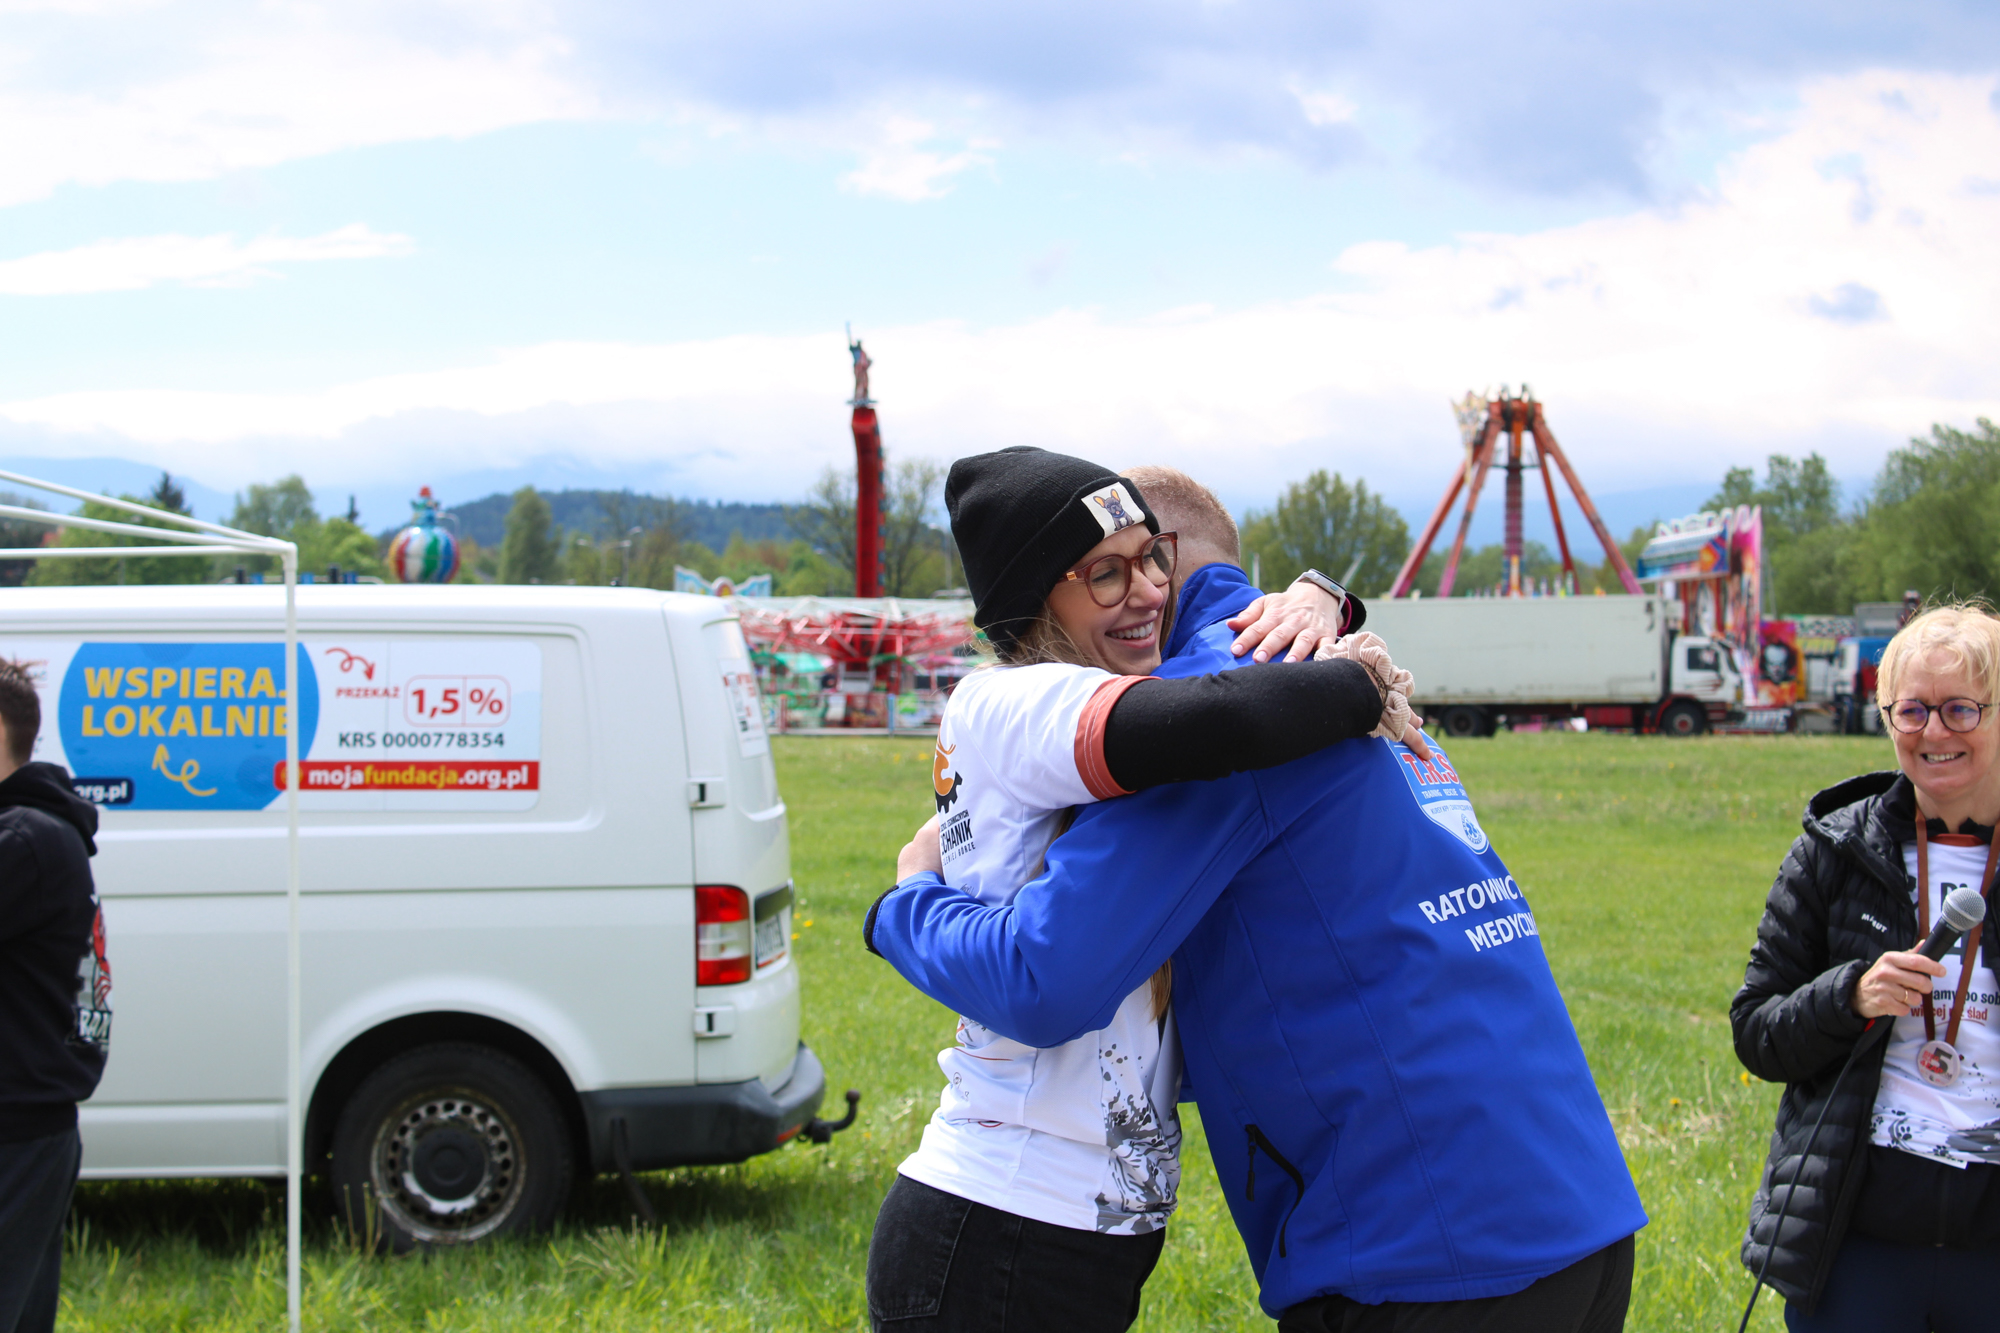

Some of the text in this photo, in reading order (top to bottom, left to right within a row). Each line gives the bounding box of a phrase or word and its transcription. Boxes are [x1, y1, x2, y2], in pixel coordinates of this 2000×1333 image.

[84, 667, 287, 698] WSPIERA
[82, 705, 287, 737] LOKALNIE
[338, 732, 505, 749] KRS 0000778354
[308, 764, 529, 790] mojafundacja.org.pl
[73, 781, 128, 802] org.pl
[941, 819, 973, 855] CHANIK
[1464, 911, 1540, 953] MEDYCZN
[1910, 1005, 1946, 1021] wicej
[1967, 1006, 1988, 1021] ślad
